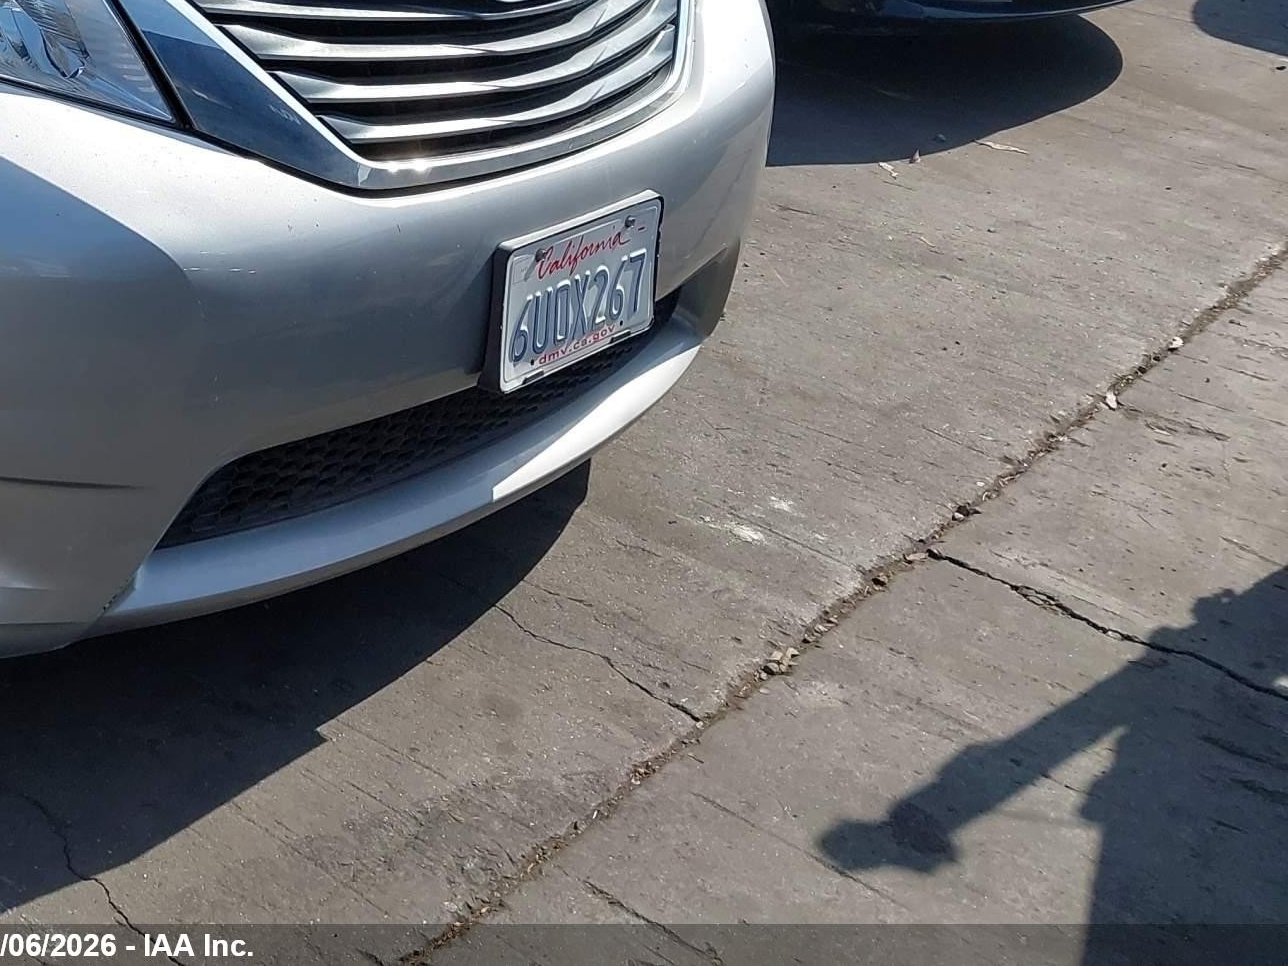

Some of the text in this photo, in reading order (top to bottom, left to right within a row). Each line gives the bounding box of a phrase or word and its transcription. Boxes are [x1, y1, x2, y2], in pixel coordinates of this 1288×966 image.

[535, 233, 631, 280] California
[510, 248, 647, 367] 6UDX267
[537, 324, 616, 366] dmv.ca.gov
